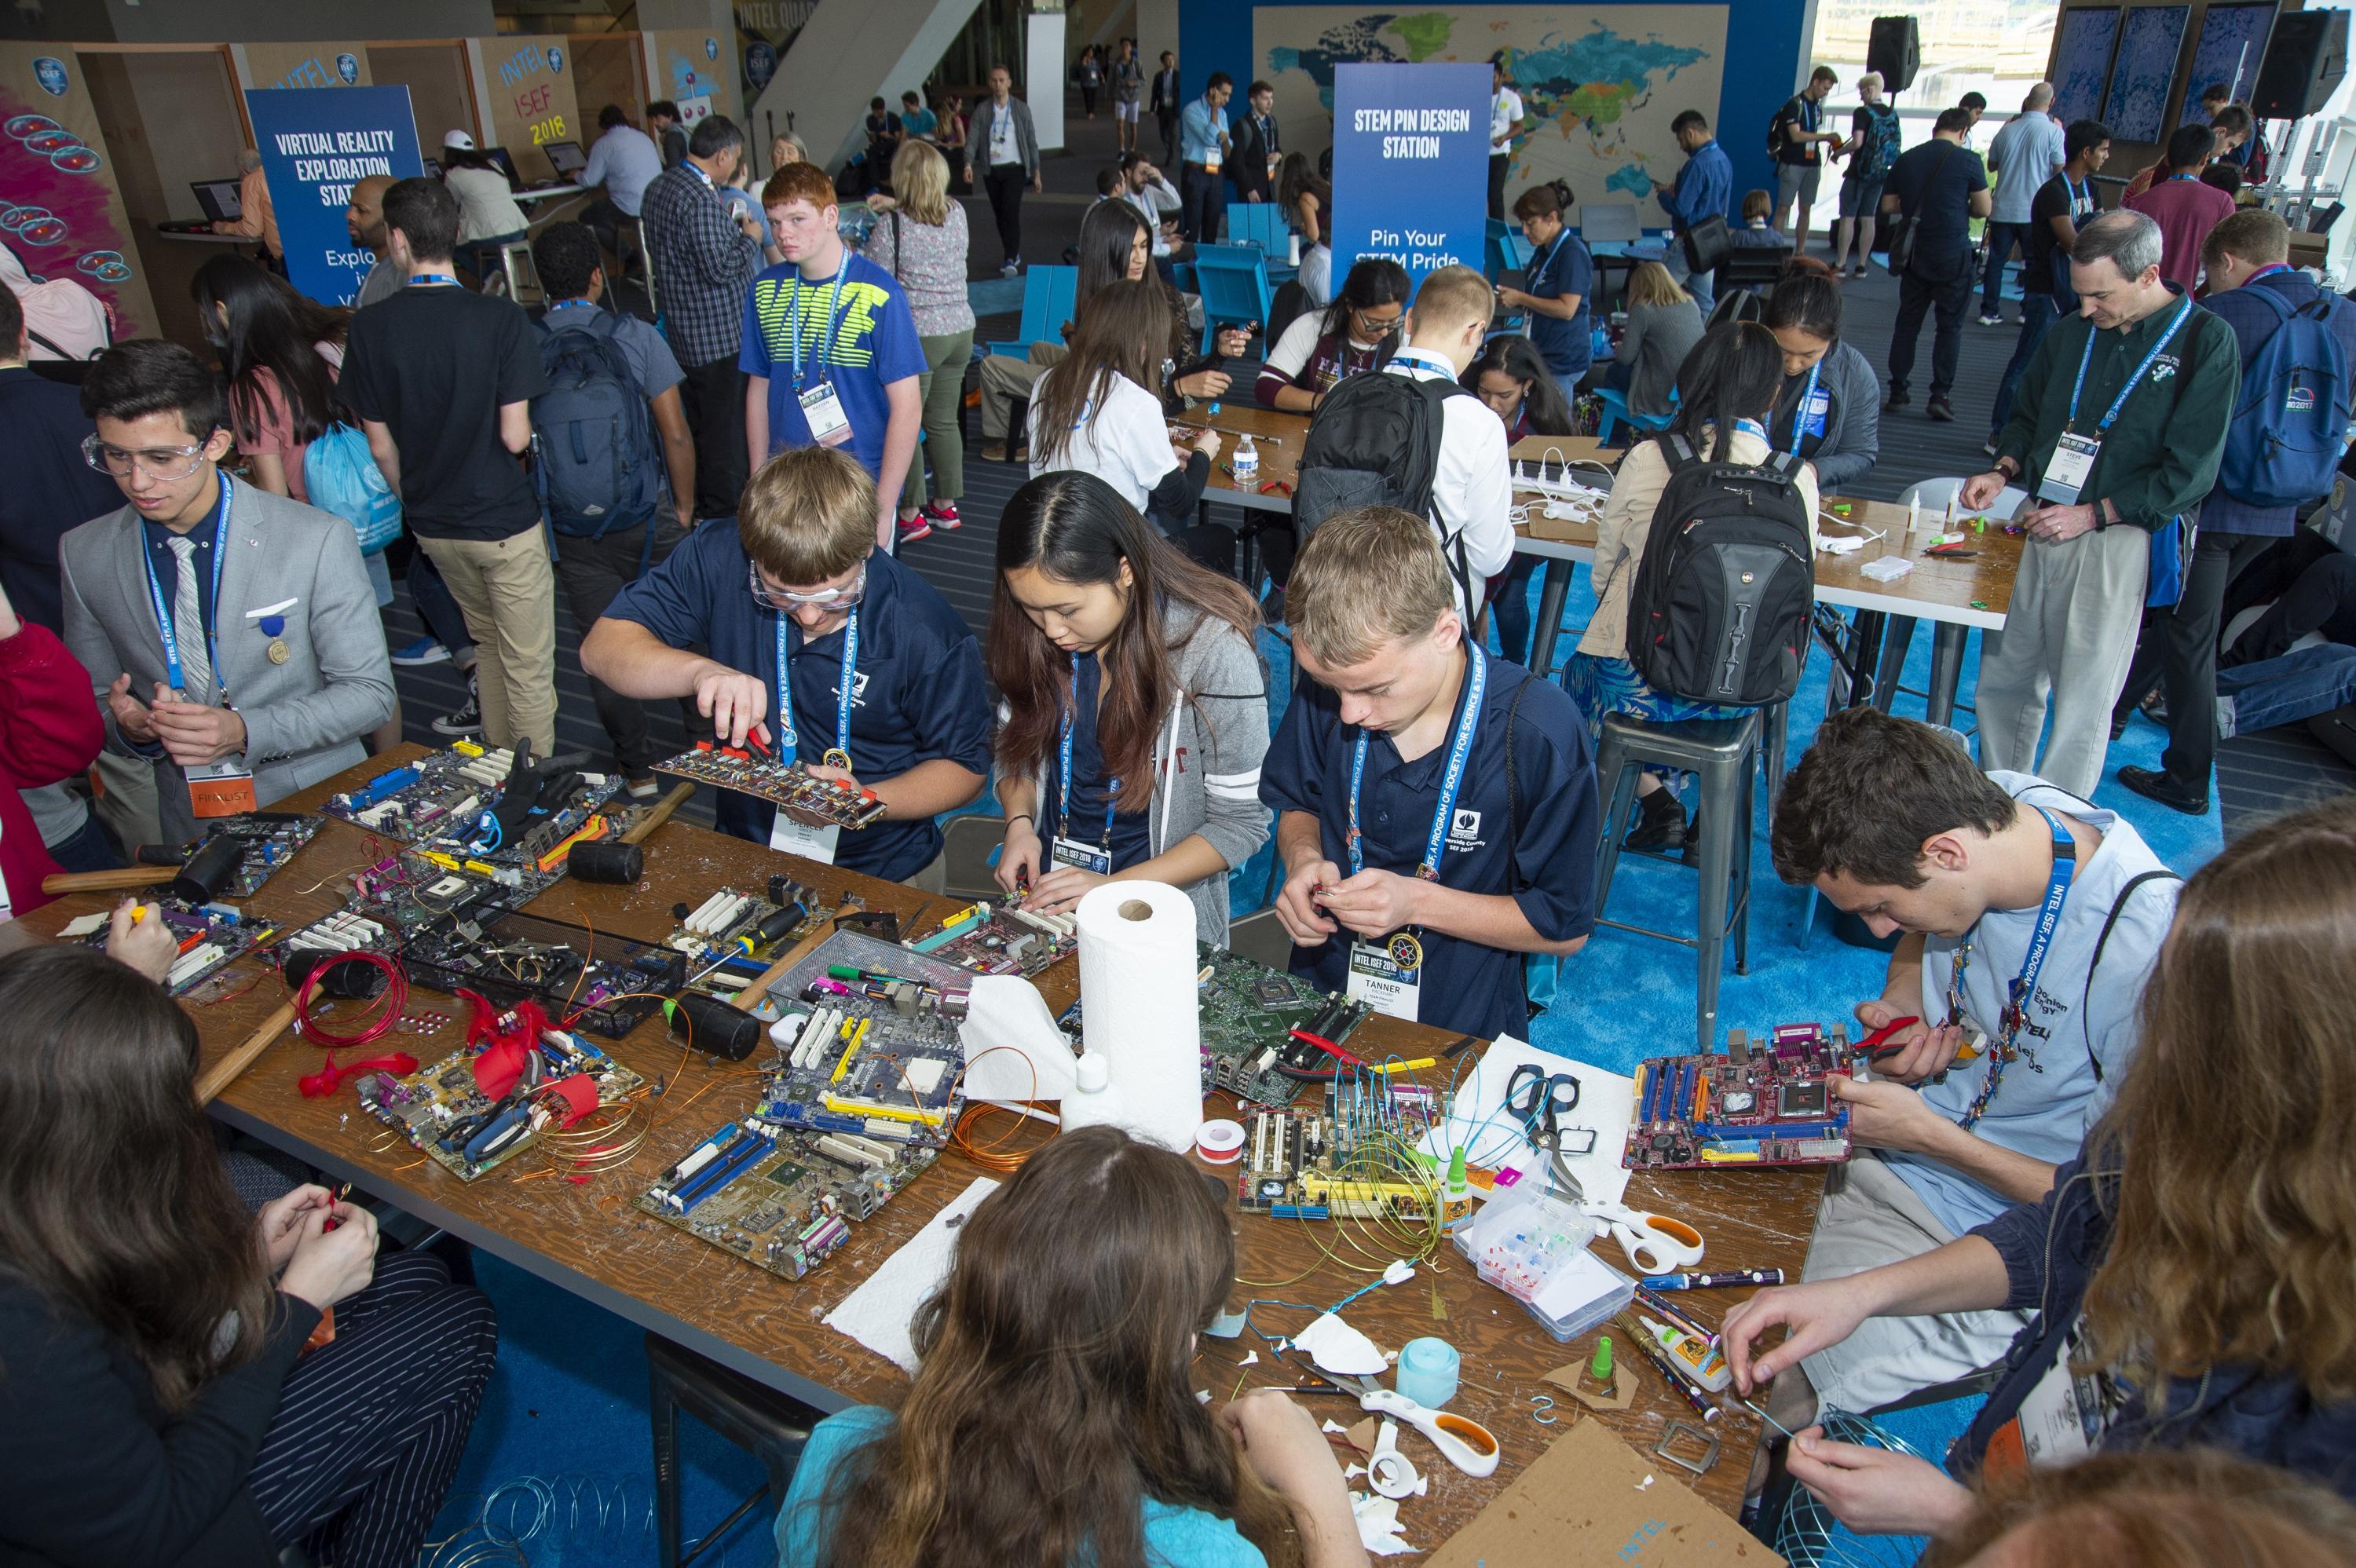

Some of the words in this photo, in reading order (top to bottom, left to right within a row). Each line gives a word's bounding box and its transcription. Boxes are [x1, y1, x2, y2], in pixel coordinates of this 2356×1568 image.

[499, 43, 545, 89] INTEL
[514, 83, 550, 119] ISEF
[529, 115, 565, 144] 2018
[1354, 108, 1392, 132] STEM
[1393, 108, 1418, 132] PIN
[1420, 108, 1470, 132] DESIGN
[275, 132, 338, 156] VIRTUAL
[336, 130, 394, 150] REALITY
[1382, 135, 1440, 159] STATION
[294, 157, 392, 182] EXPLORATION
[320, 184, 355, 207] STAT
[1370, 229, 1399, 247] Pin
[1404, 229, 1447, 247] Your
[326, 249, 376, 269] Explo
[1412, 251, 1459, 270] Pride
[2173, 308, 2190, 330] PROGRAM
[2168, 328, 2175, 338] OF
[2153, 335, 2170, 355] SOCIETY
[2146, 353, 2156, 364] FOR
[2133, 363, 2149, 382] SCIENCE
[2066, 451, 2082, 460] STEVE
[850, 615, 858, 631] FOR
[167, 644, 177, 664] INTEL
[845, 633, 857, 664] SOCIETY
[843, 663, 852, 674] OF
[1474, 663, 1483, 684] THE
[841, 674, 851, 712] PROGRAM
[1472, 685, 1480, 693] &
[1462, 698, 1478, 733] SCIENCE
[838, 736, 847, 752] NTEL
[1356, 729, 1366, 767] SOCIETY
[1455, 732, 1469, 752] FOR
[1353, 766, 1362, 784] FOR
[1445, 750, 1463, 791] SOCIETY
[198, 791, 248, 803] FINALIST
[1442, 789, 1451, 804] OF
[1430, 802, 1447, 842] PROGRAM
[1055, 845, 1069, 857] INTEL
[1069, 849, 1079, 860] ISEF
[1079, 852, 1091, 863] 2018
[2049, 883, 2065, 912] INTEL
[2039, 911, 2056, 938] ISEF,
[2037, 934, 2046, 945] A
[1354, 953, 1370, 967] INTEL
[1370, 956, 1383, 969] ISEF
[1383, 959, 1397, 973] 2018
[1365, 979, 1401, 994] TANNER
[1615, 1519, 1667, 1563] INTEL
